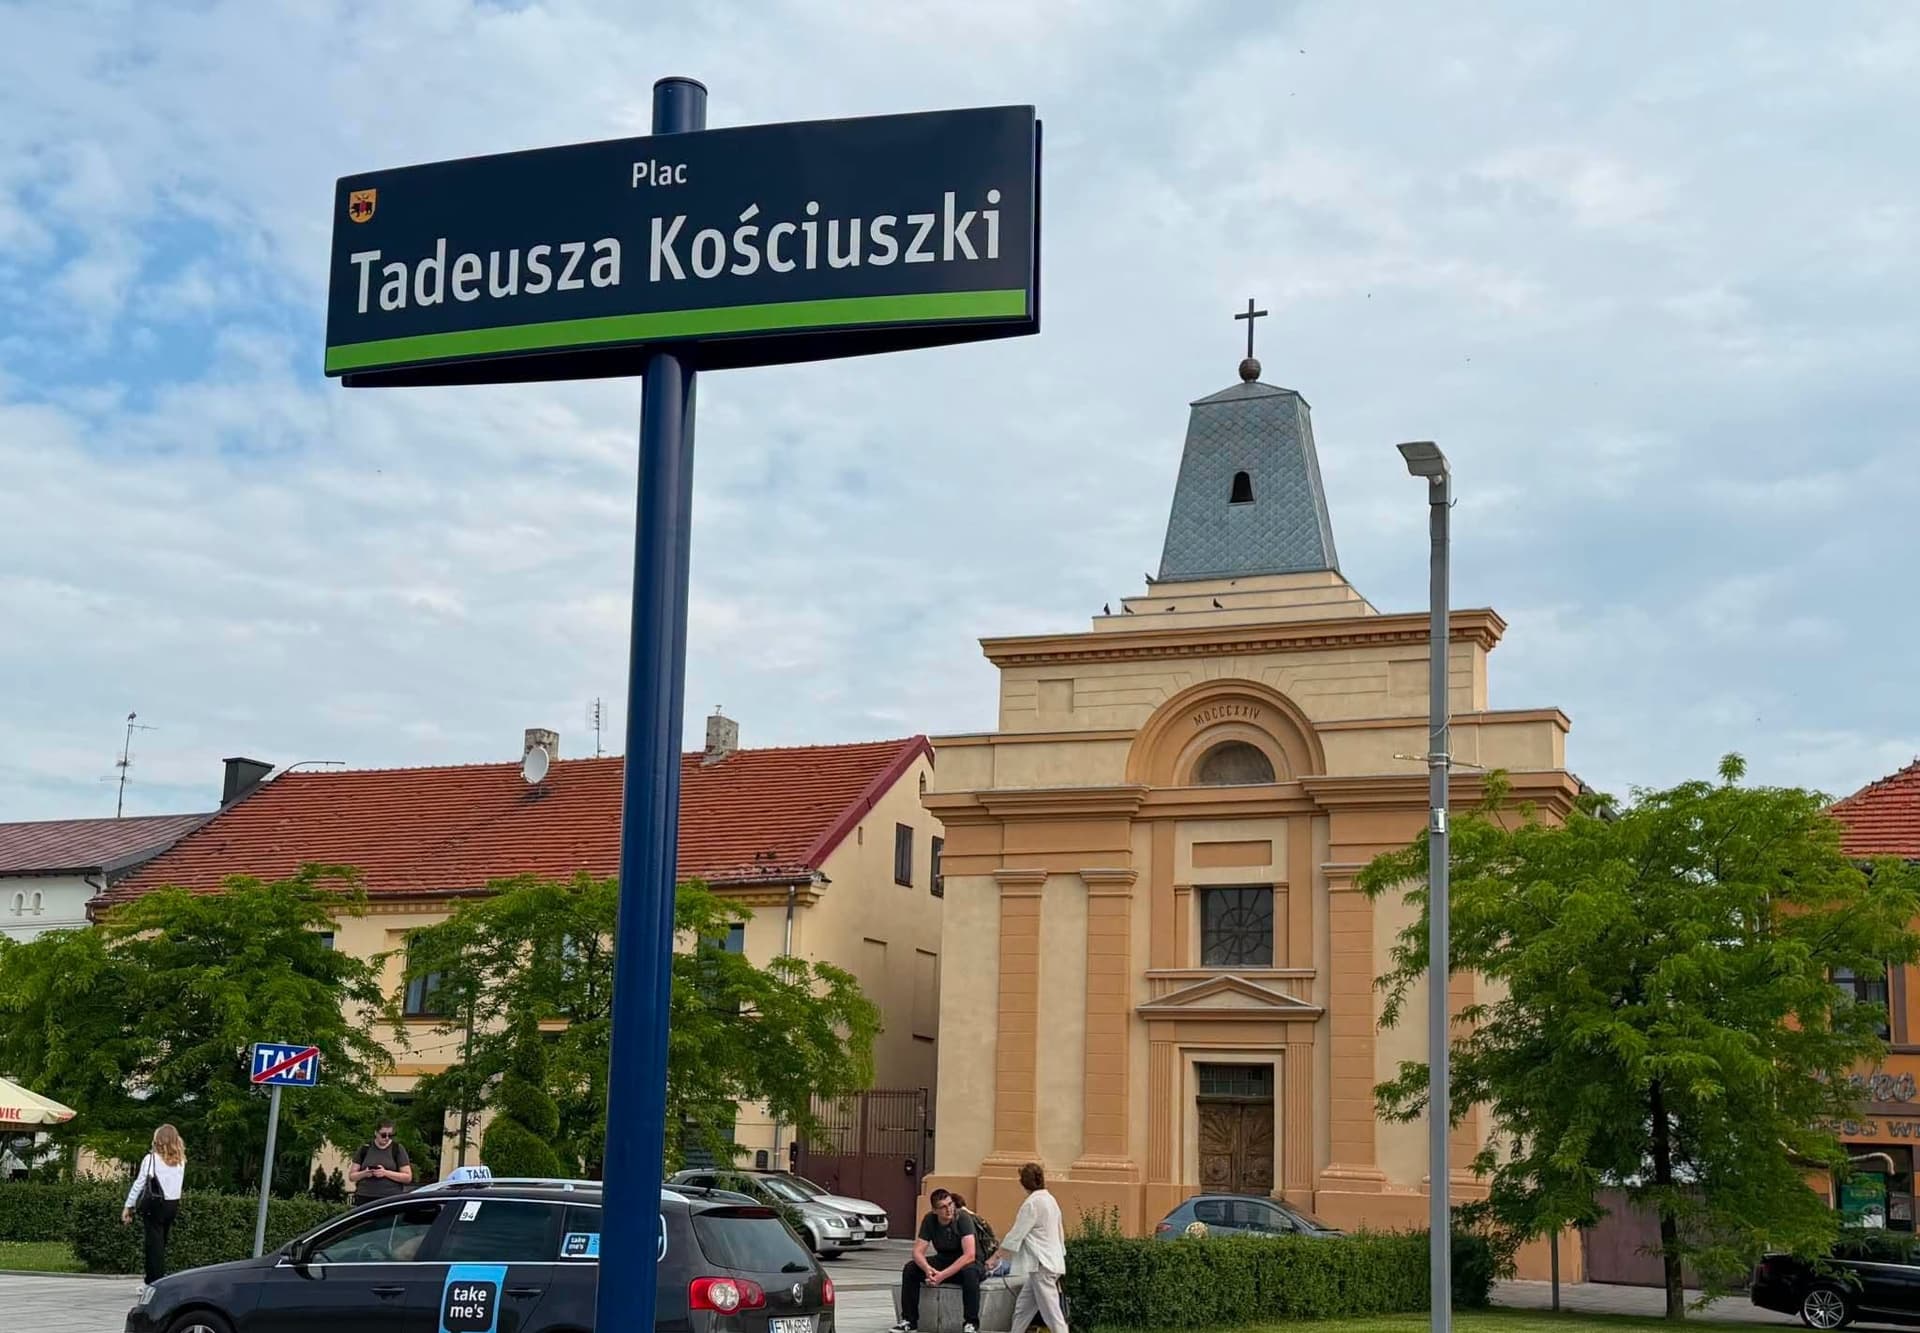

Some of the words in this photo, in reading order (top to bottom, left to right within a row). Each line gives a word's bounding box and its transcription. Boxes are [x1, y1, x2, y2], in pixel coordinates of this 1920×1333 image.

[632, 160, 688, 188] Plac
[350, 237, 622, 315] Tadeusza
[649, 188, 1001, 283] Kościuszki
[258, 1049, 314, 1081] TAXI
[466, 1168, 490, 1180] TAXI
[453, 1285, 487, 1302] take
[449, 1303, 485, 1319] me's
